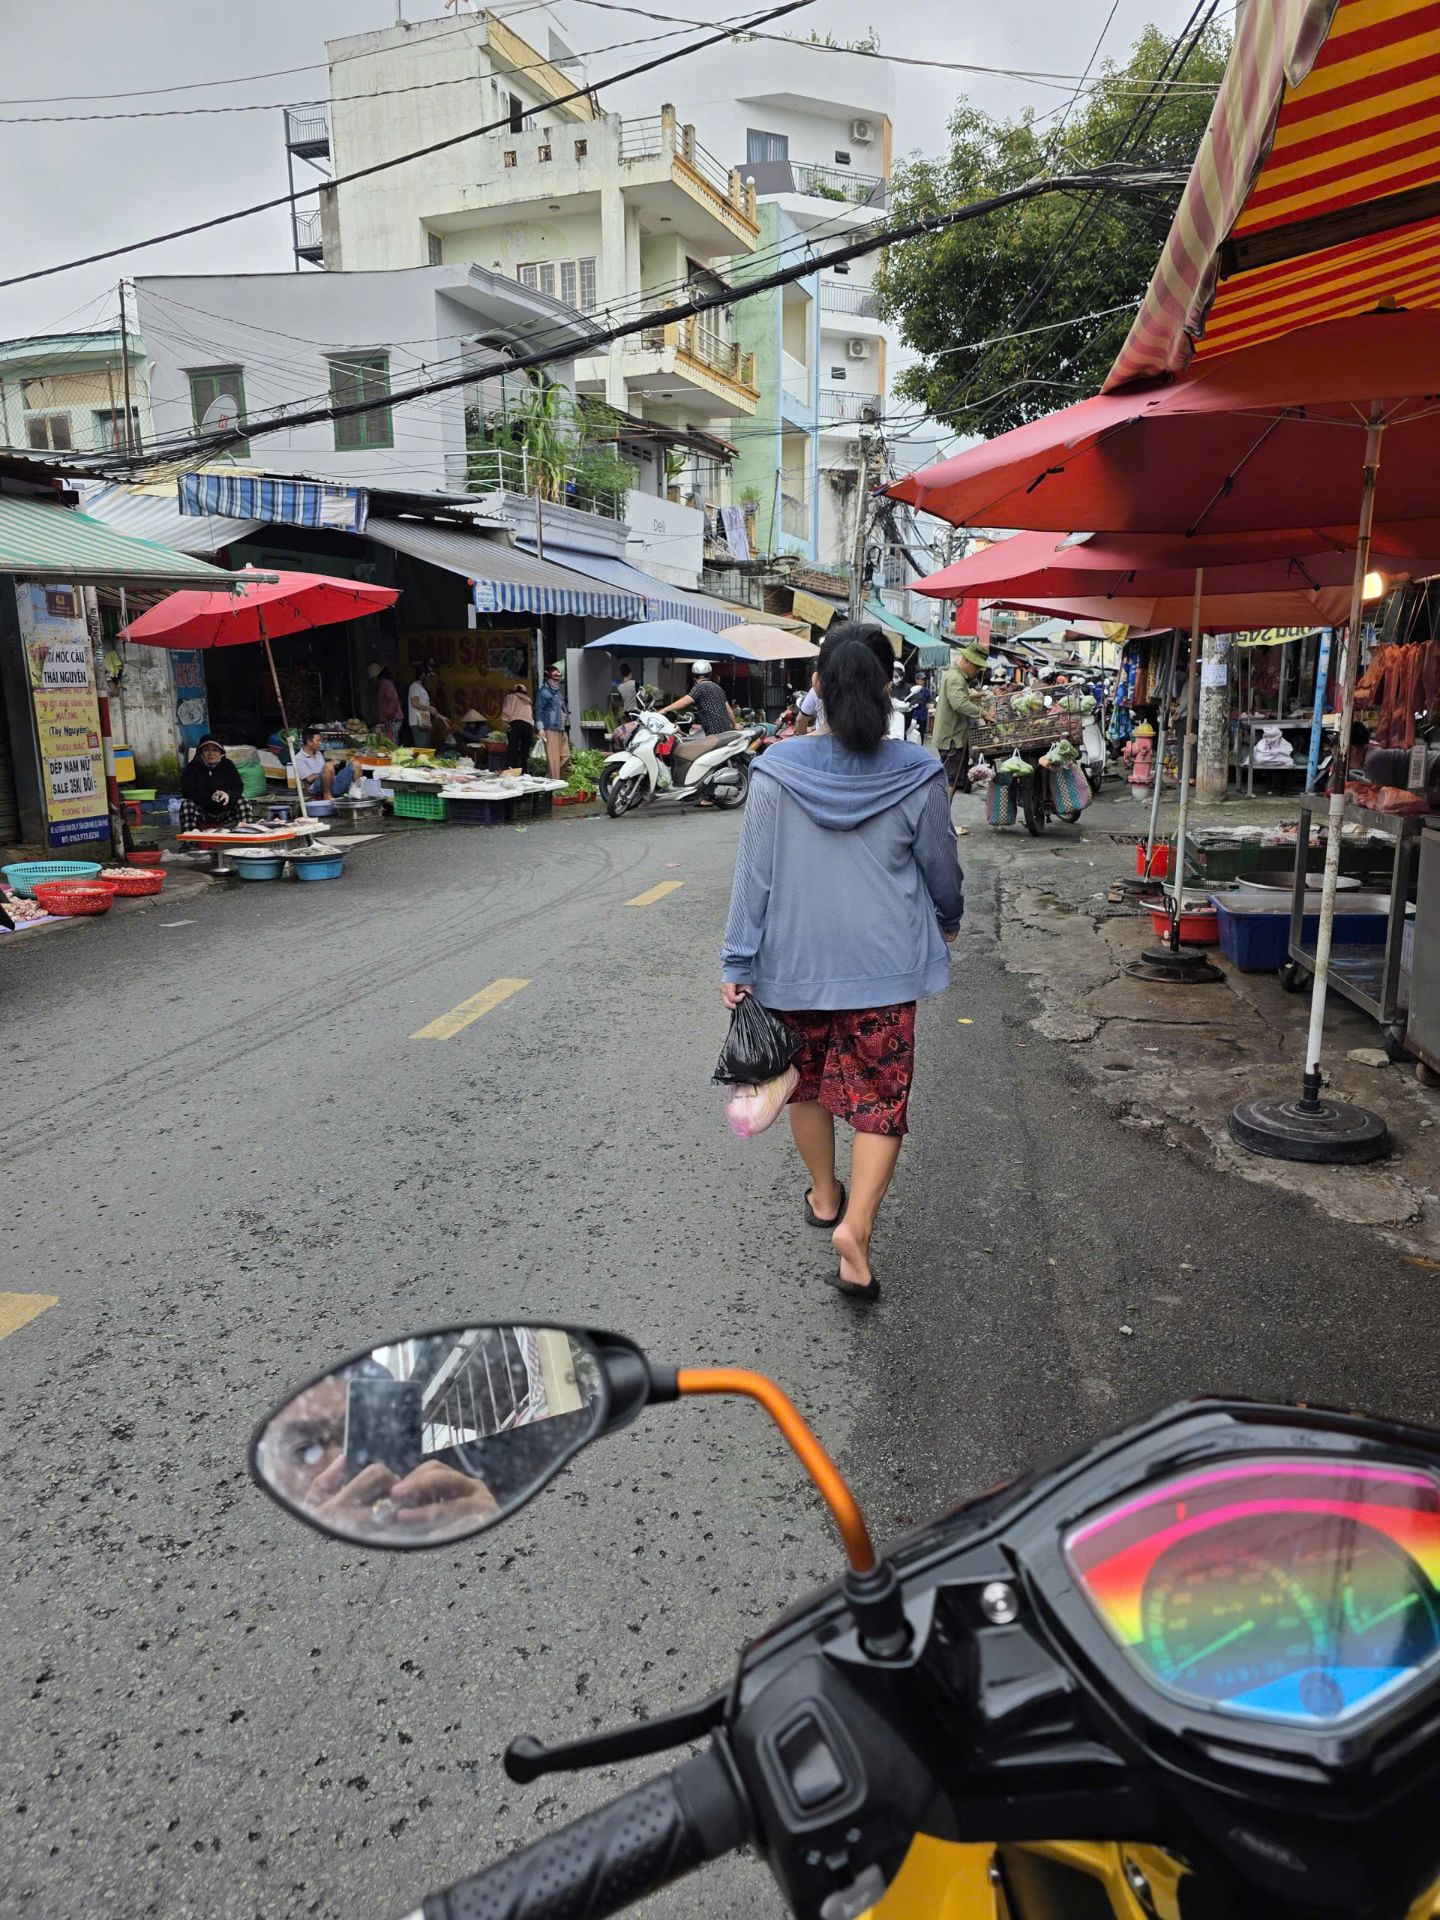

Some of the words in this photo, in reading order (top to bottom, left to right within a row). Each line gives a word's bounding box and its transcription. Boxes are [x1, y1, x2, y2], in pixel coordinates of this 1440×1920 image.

[60, 668, 87, 683] NGUYÊN
[63, 760, 80, 773] NAM
[52, 782, 69, 795] SALE
